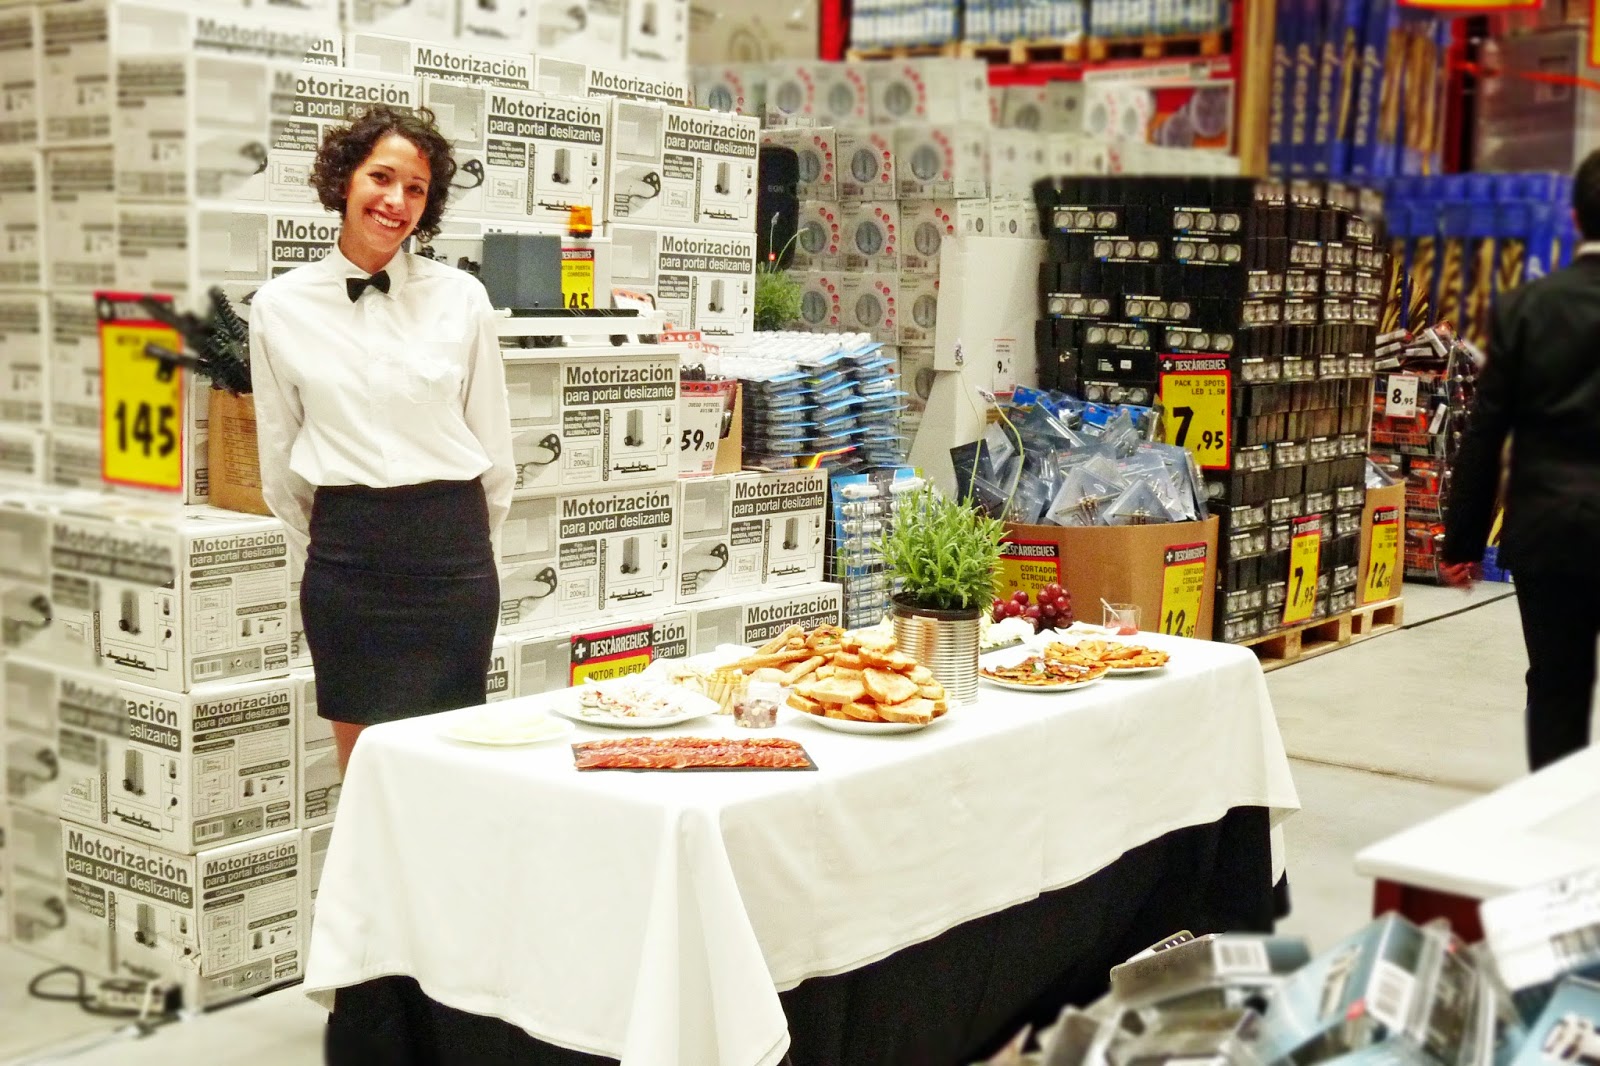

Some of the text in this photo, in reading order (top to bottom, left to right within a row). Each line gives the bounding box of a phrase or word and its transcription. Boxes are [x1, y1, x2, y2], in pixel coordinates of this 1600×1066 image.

[417, 47, 527, 78] Motorización
[591, 70, 683, 98] Motorización
[308, 102, 344, 117] portal
[491, 96, 601, 125] Motorización
[489, 121, 601, 142] para portal deslizante
[668, 115, 756, 141] Motorización
[666, 136, 755, 157] para portal deslizante
[275, 245, 304, 260] para
[662, 236, 750, 257] Motorización
[660, 256, 750, 272] para portal deslizante
[566, 363, 673, 385] Motorización
[1203, 379, 1226, 387] SPOTS
[565, 386, 673, 404] para portal deslizante
[114, 401, 175, 457] 145
[681, 429, 715, 452] 59,90
[735, 475, 823, 499] Motorización
[563, 490, 670, 518] Motorización
[733, 495, 823, 516] para portal deslizante
[562, 511, 670, 537] para portal deslizante
[193, 531, 284, 553] Motorización
[192, 545, 285, 566] para portal deslizante
[1020, 565, 1057, 574] CORTADOR
[1021, 573, 1058, 582] CIRCULAR
[747, 595, 837, 624] Motorización
[746, 628, 767, 643] para
[588, 663, 646, 680] MOTOR PUERTA
[195, 691, 288, 717] Motorización
[194, 704, 289, 731] para portal deslizante
[129, 721, 179, 747] eslizante
[68, 830, 187, 885] Motorización
[206, 843, 296, 876] Motorización
[68, 856, 190, 905] para portal deslizante
[205, 857, 296, 888] para portal deslizante
